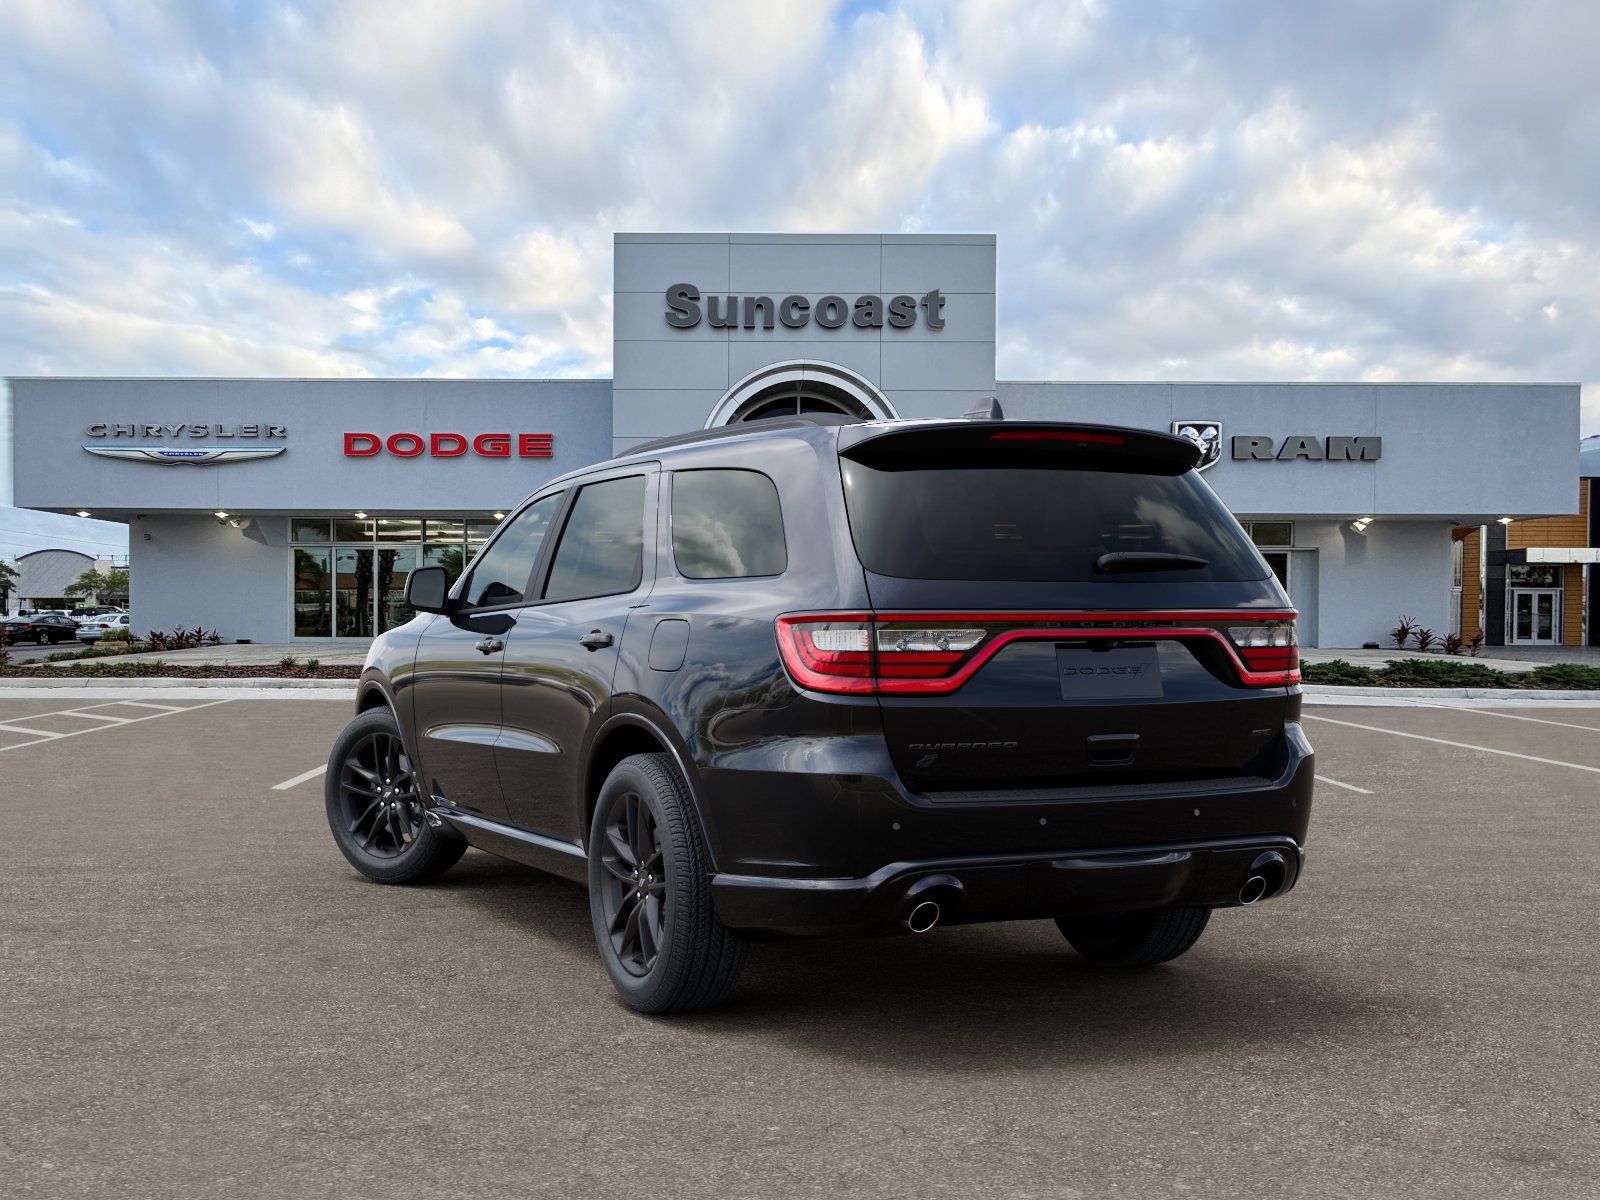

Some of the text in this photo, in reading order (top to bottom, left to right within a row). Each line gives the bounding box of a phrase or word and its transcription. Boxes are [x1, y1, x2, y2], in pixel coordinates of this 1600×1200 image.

[665, 282, 946, 329] Suncoast
[85, 423, 288, 438] CHRYSLER
[343, 432, 554, 457] DODGE
[1231, 435, 1382, 460] RAM
[1063, 666, 1142, 676] DODGE
